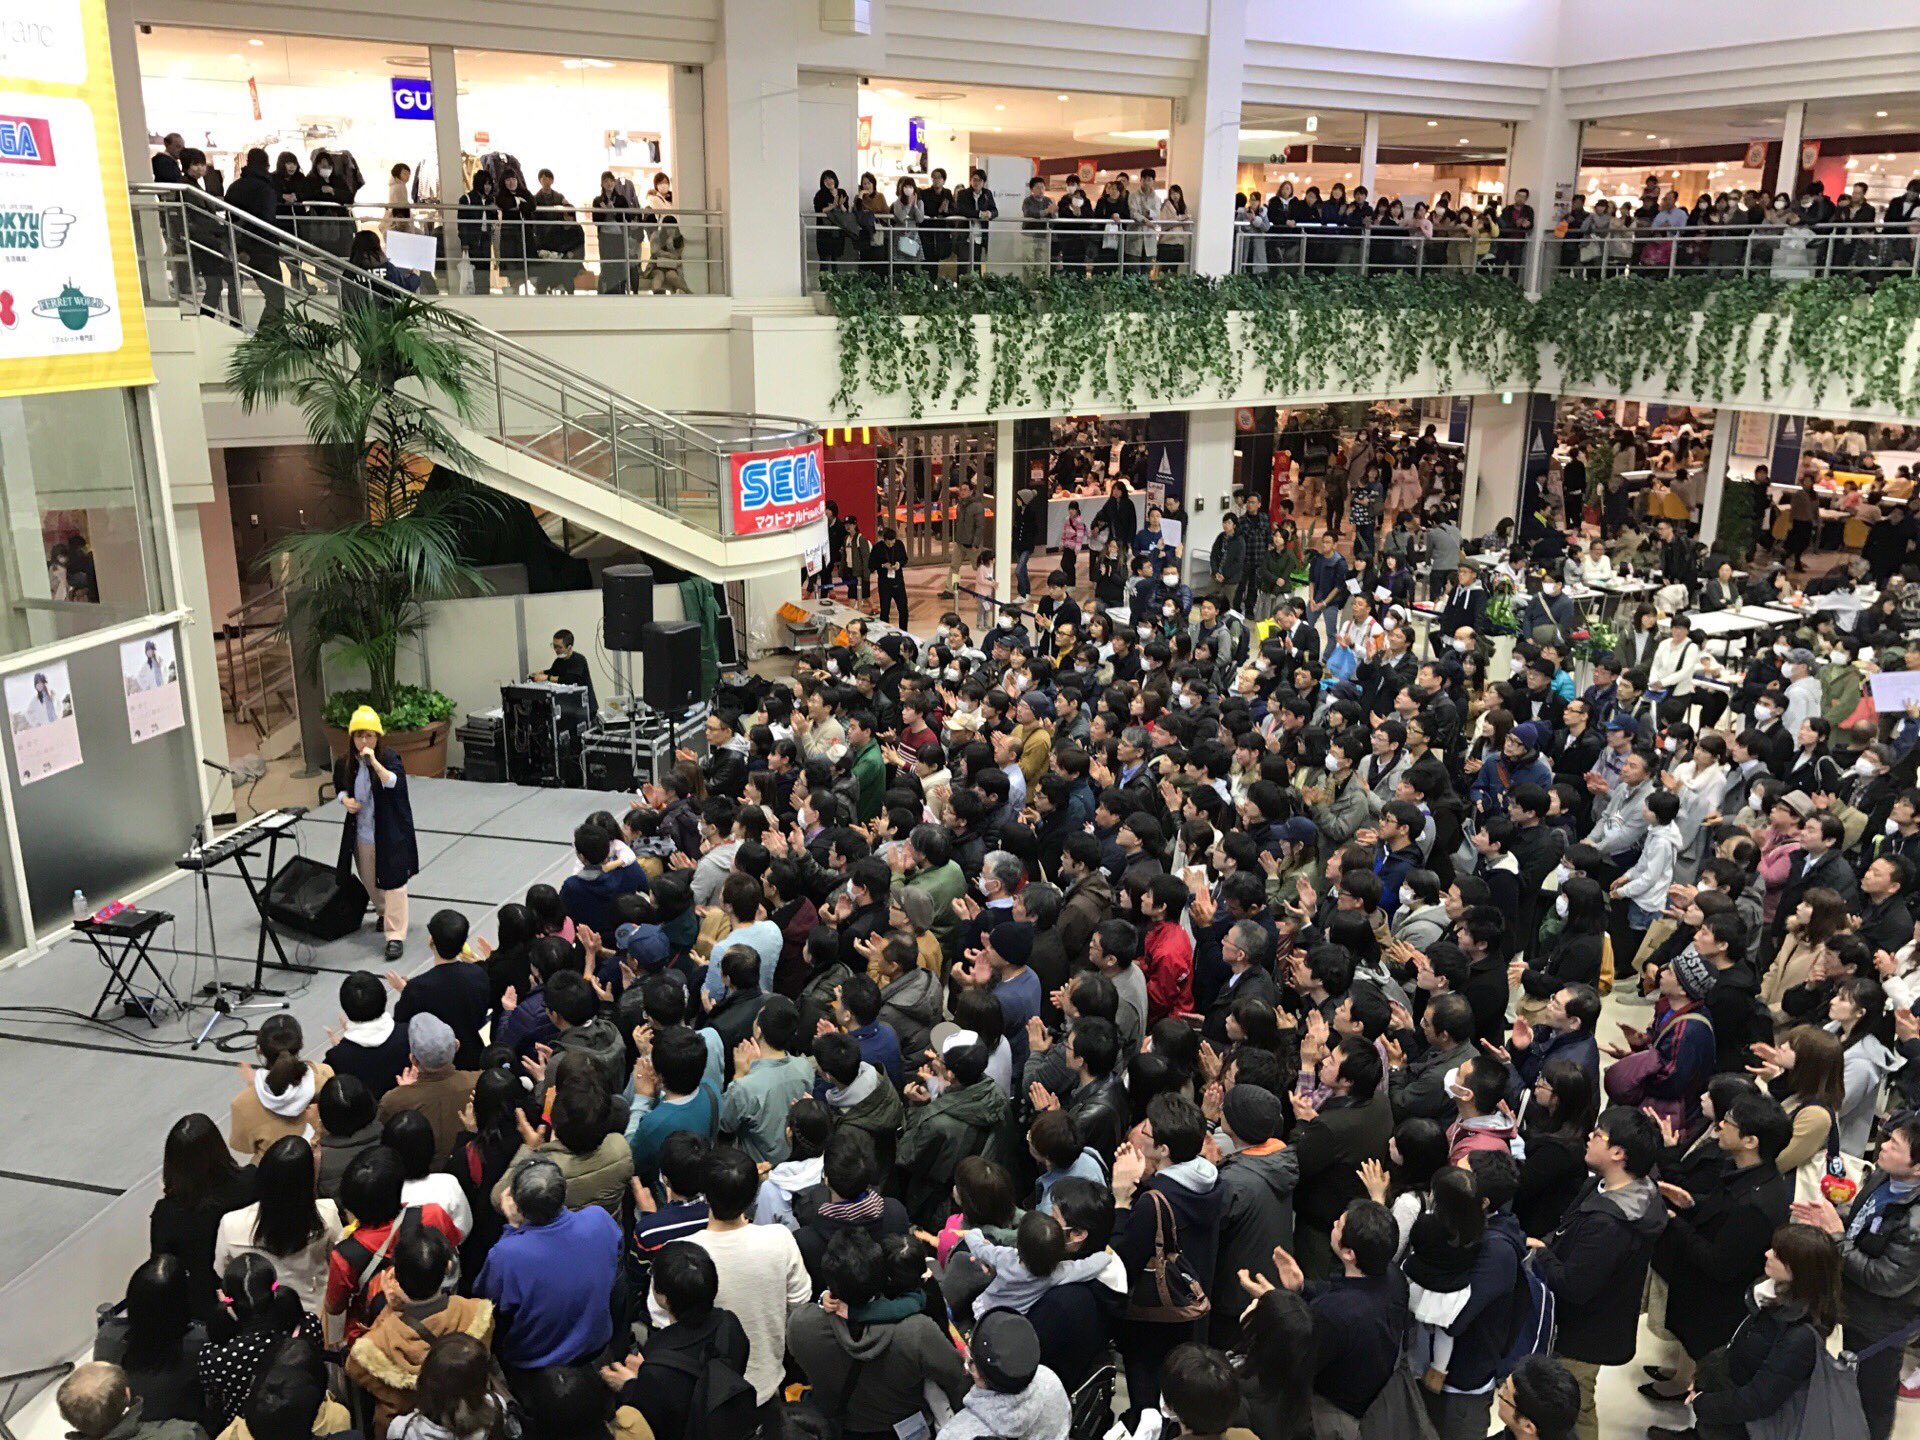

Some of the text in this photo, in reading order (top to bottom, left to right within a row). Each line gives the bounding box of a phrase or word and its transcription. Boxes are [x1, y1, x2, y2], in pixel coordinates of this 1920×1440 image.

[395, 88, 432, 111] GU
[39, 296, 103, 311] FERRET WORLD
[740, 451, 822, 511] SEGA
